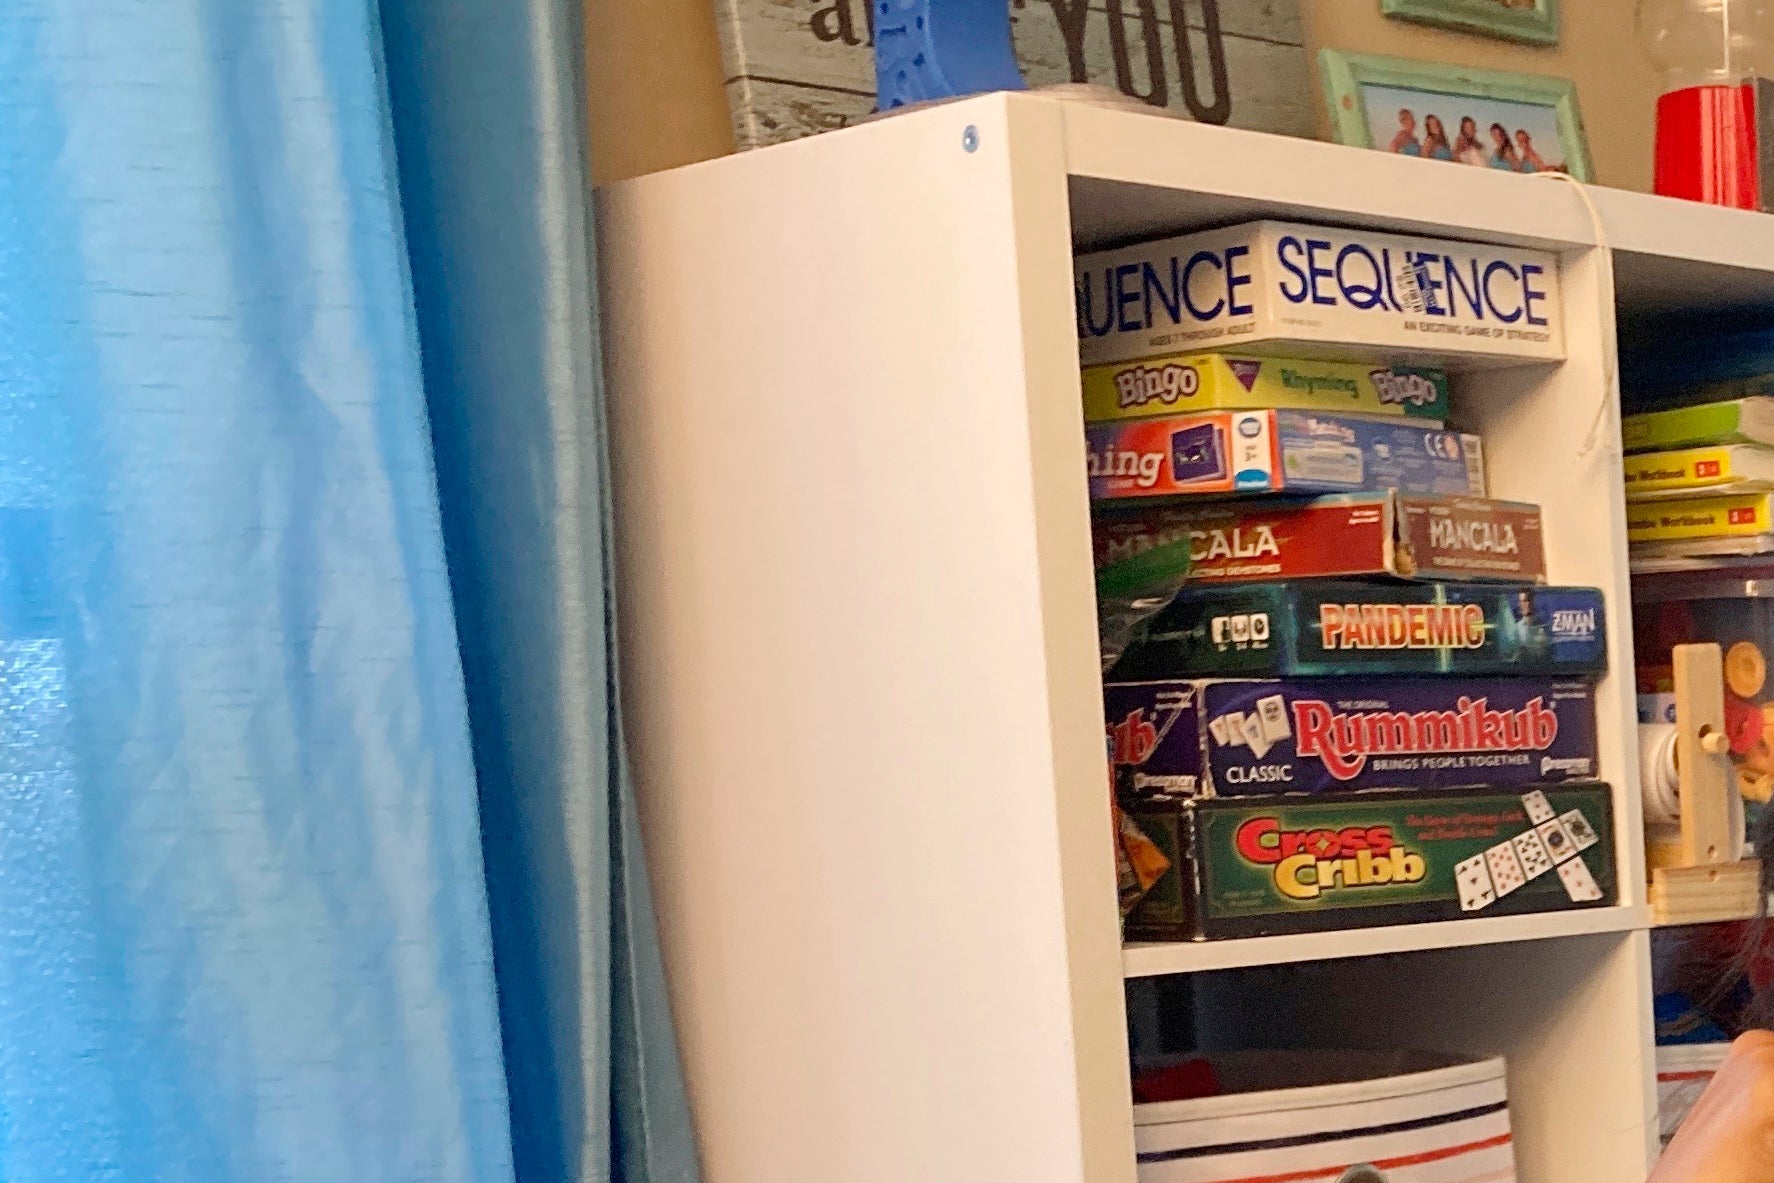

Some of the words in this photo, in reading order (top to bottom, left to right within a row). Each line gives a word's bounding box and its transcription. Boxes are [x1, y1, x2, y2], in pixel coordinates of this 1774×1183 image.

[1079, 245, 1254, 337] UENCE
[1278, 235, 1549, 326] SEQUENCE
[1113, 363, 1199, 409] Bingo
[1368, 367, 1438, 407] Bingo
[1429, 518, 1520, 555] MANCALA
[1319, 603, 1486, 650] PANDEMIC
[1291, 695, 1559, 781] Rummikub
[1225, 764, 1294, 784] CLASSIC
[1372, 758, 1419, 771] BRINGS
[1422, 756, 1465, 769] PEOPLE
[1469, 754, 1530, 767] TOGETHER
[1236, 816, 1395, 865] Cross
[1274, 844, 1426, 900] Cribb
